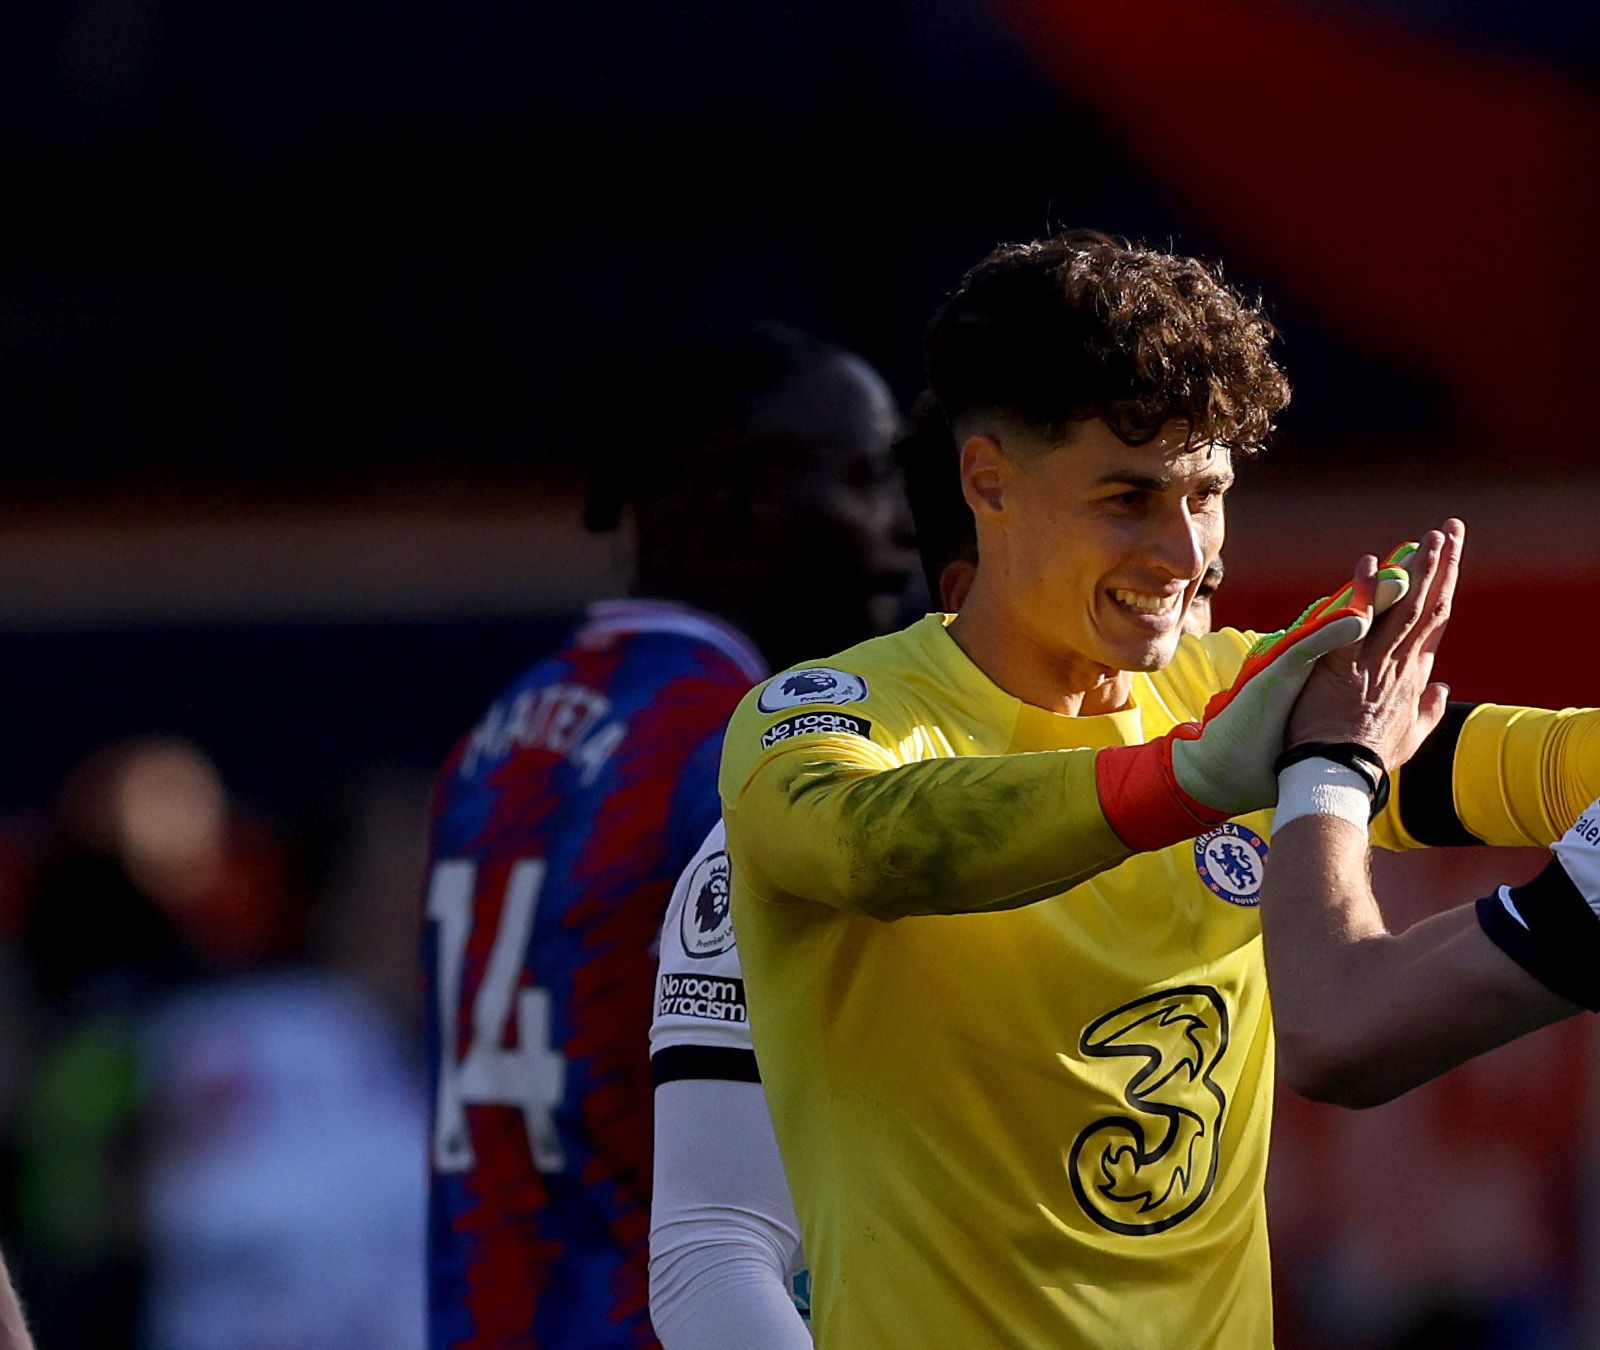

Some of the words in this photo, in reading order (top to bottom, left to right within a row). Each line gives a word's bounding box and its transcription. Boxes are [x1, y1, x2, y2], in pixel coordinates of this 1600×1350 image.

[762, 723, 791, 745] No
[795, 714, 860, 732] room
[1195, 823, 1240, 855] CHELSEA
[662, 975, 679, 997] No
[679, 978, 737, 1001] room
[427, 859, 568, 1172] 14
[671, 996, 746, 1021] racism
